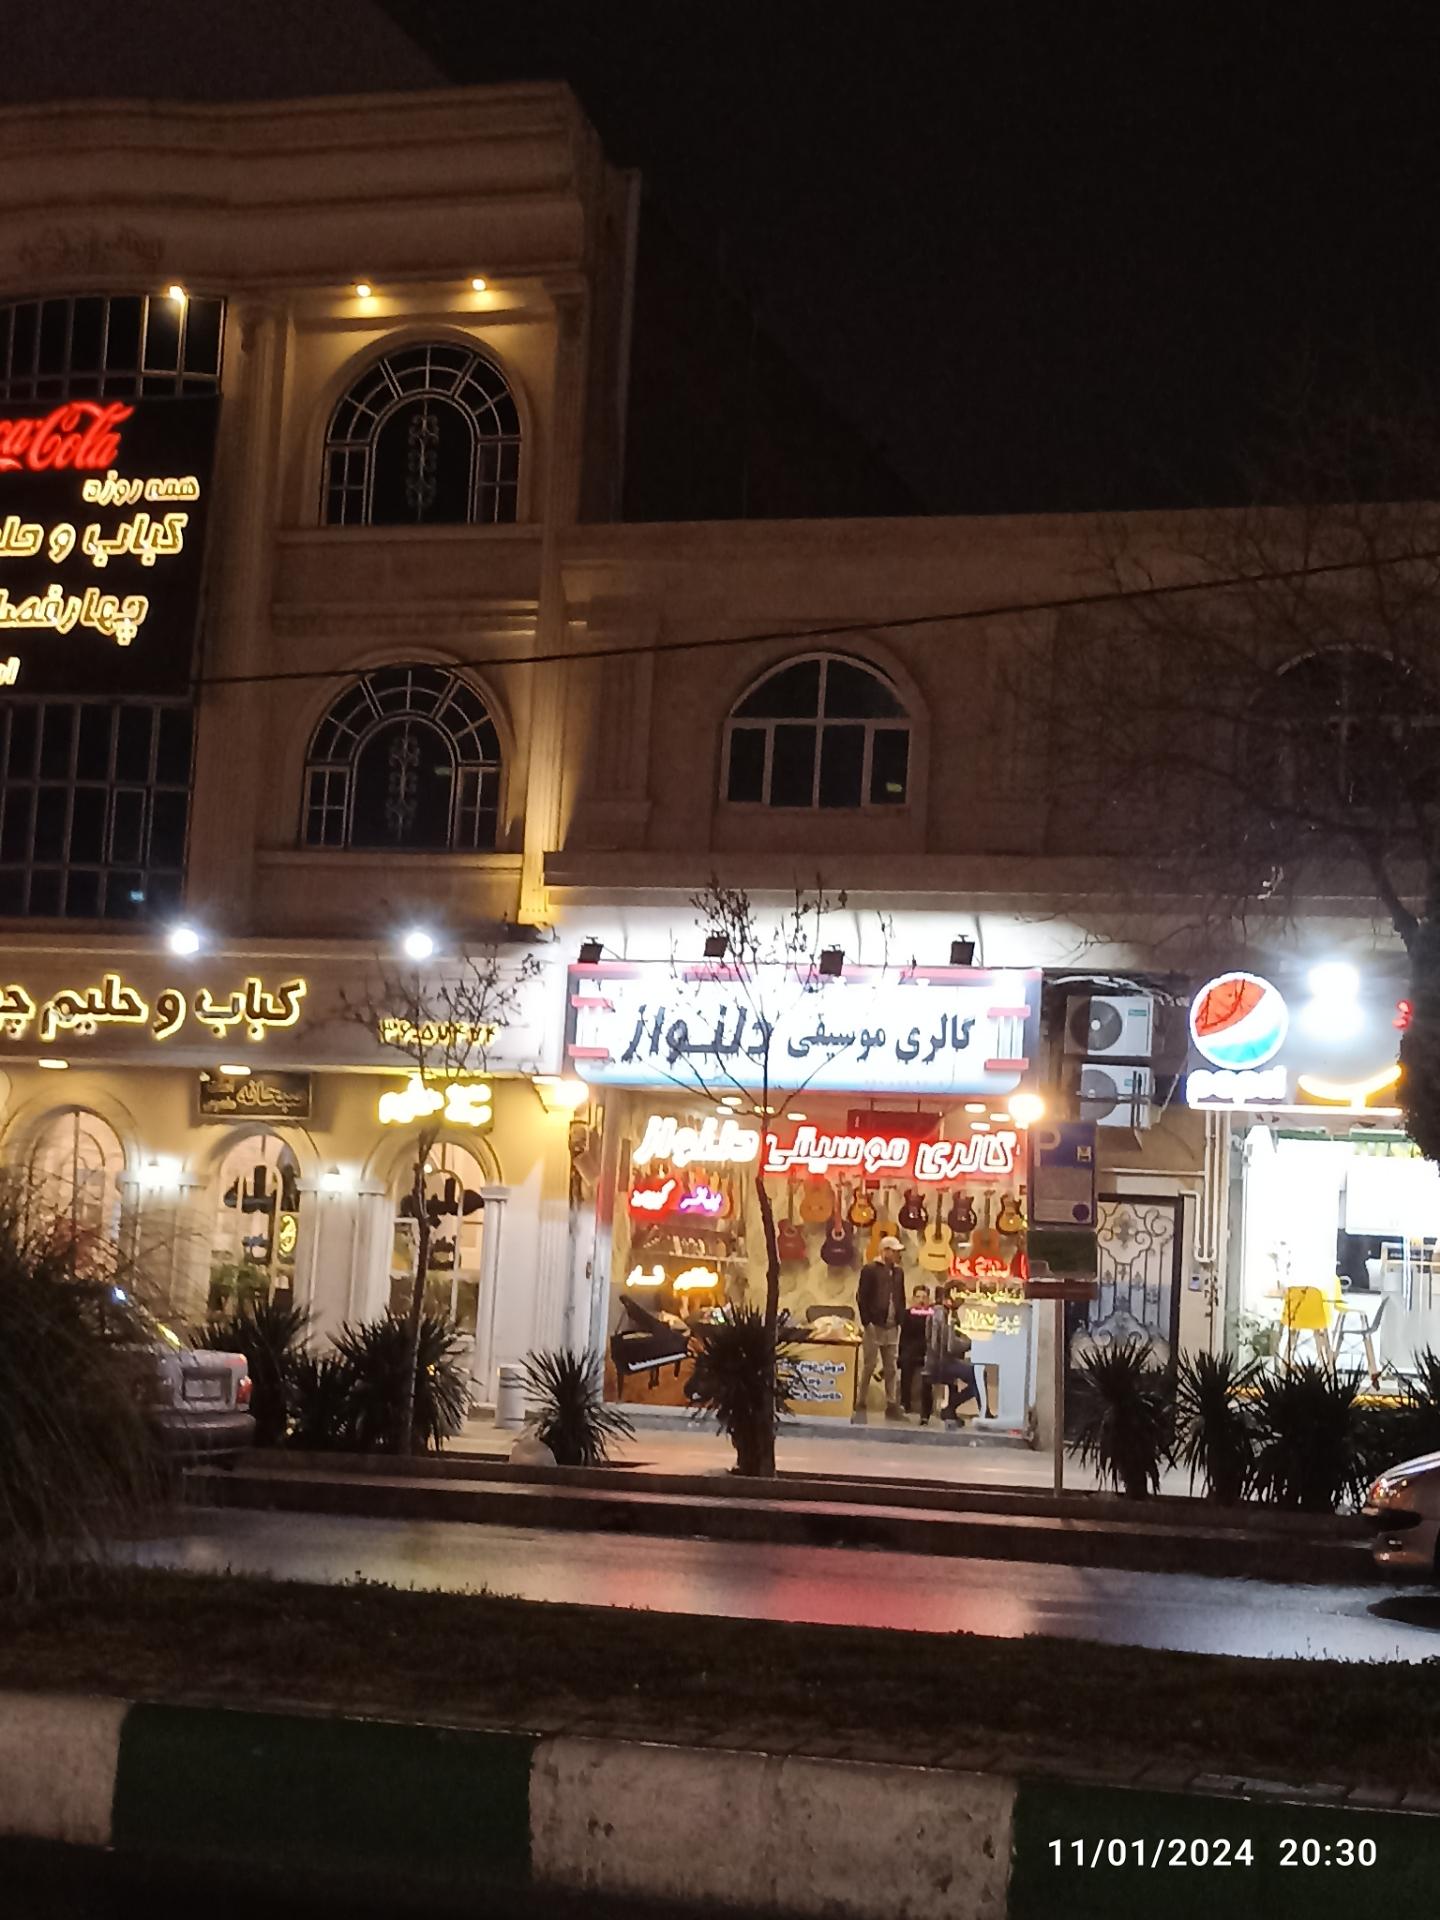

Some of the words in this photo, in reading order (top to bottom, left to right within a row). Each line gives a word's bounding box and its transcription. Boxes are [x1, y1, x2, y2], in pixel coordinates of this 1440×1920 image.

[82, 469, 144, 507] روزه
[144, 475, 200, 501] همه
[0, 516, 44, 557] حل
[49, 522, 76, 564] و
[82, 513, 188, 567] کباب
[40, 974, 149, 1041] حلیم
[152, 988, 187, 1041] و
[194, 977, 307, 1041] کباب
[620, 1003, 775, 1063] دلنواز
[787, 1020, 886, 1062] موسیقی
